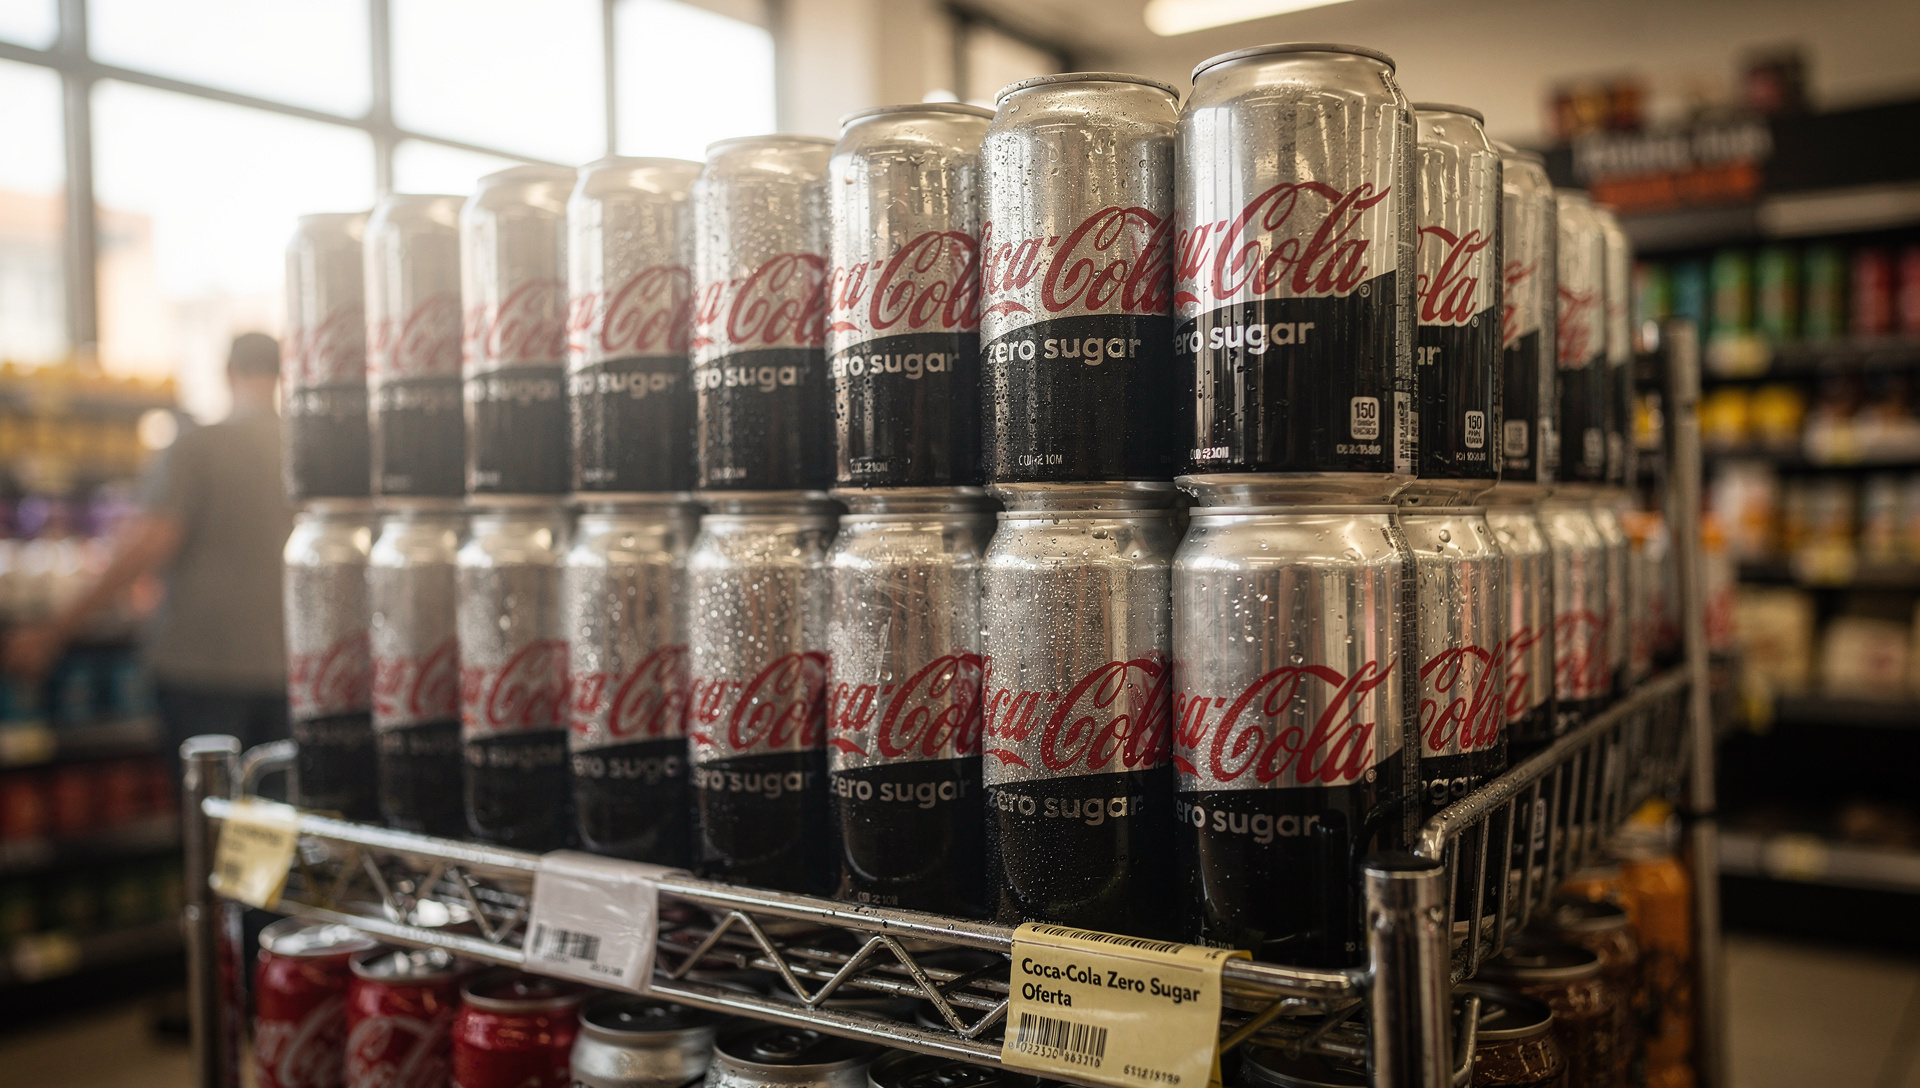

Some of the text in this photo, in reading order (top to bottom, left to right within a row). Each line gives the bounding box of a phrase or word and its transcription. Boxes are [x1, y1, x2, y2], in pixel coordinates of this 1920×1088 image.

[987, 337, 1142, 367] zero sugar
[1175, 321, 1315, 356] ero sugar
[870, 351, 960, 380] sugar
[1354, 402, 1375, 419] 150
[879, 779, 970, 809] sugar
[1043, 795, 1143, 826] sugar
[1175, 800, 1319, 844] ero sugar
[1021, 982, 1072, 1007] Oferta
[1107, 970, 1145, 993] Zero
[1150, 977, 1201, 1005] Sugar
